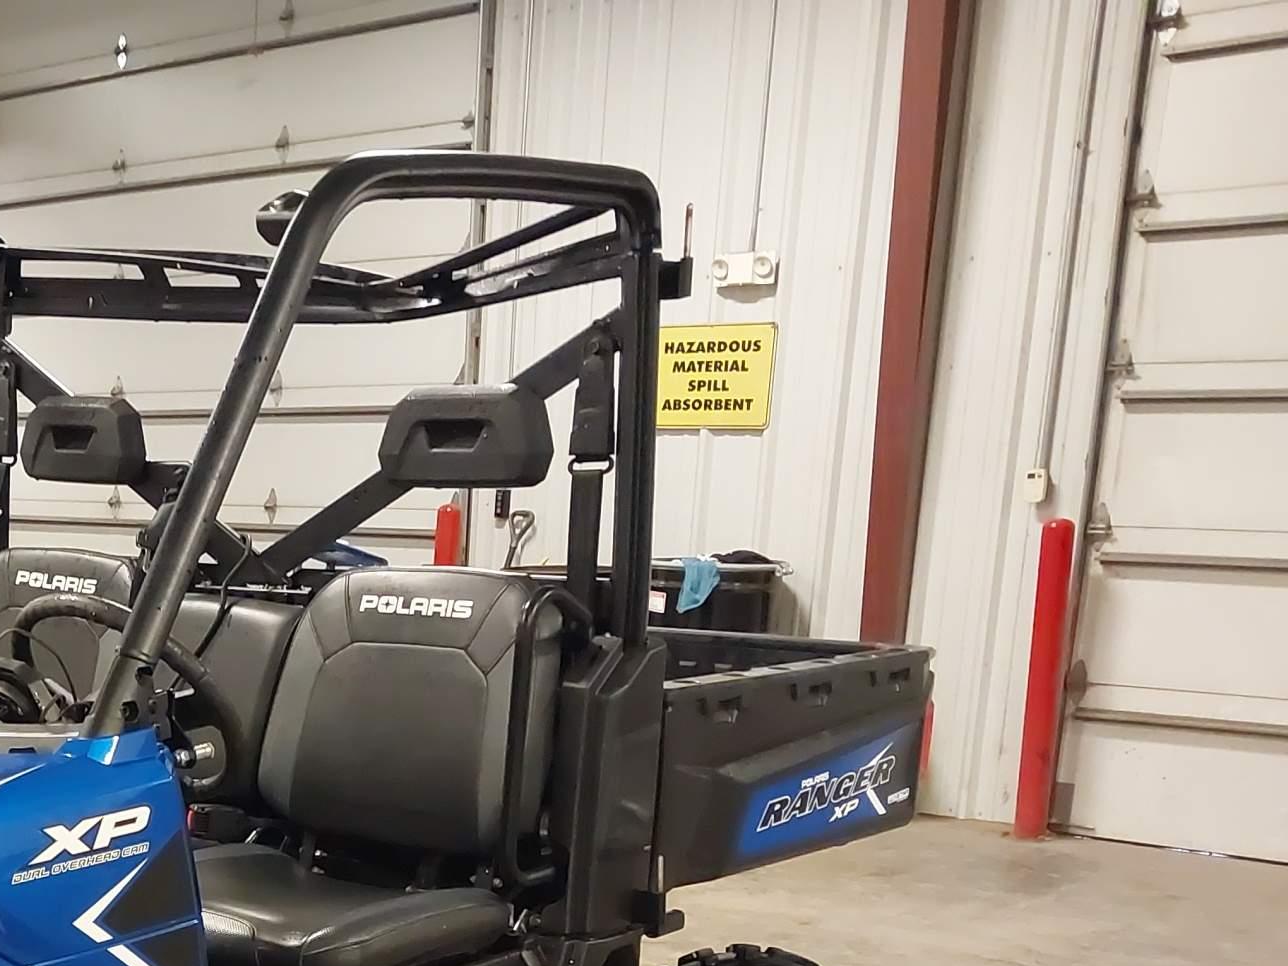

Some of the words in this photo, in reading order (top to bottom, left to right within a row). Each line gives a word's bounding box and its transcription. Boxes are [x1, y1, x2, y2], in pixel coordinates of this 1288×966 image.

[664, 340, 761, 354] HAZARDOUS
[672, 360, 749, 373] MATERIAL
[687, 379, 729, 392] SPILL
[662, 398, 754, 411] ABSORBENT
[15, 570, 97, 594] POLARIS
[359, 594, 473, 619] POLARIS
[801, 771, 829, 788] POLARIS
[756, 755, 896, 832] RANGER
[828, 799, 859, 823] XP
[28, 805, 152, 865] XP
[11, 866, 50, 885] DUAL
[51, 850, 121, 876] OVERHEAD
[120, 841, 150, 858] CAM
